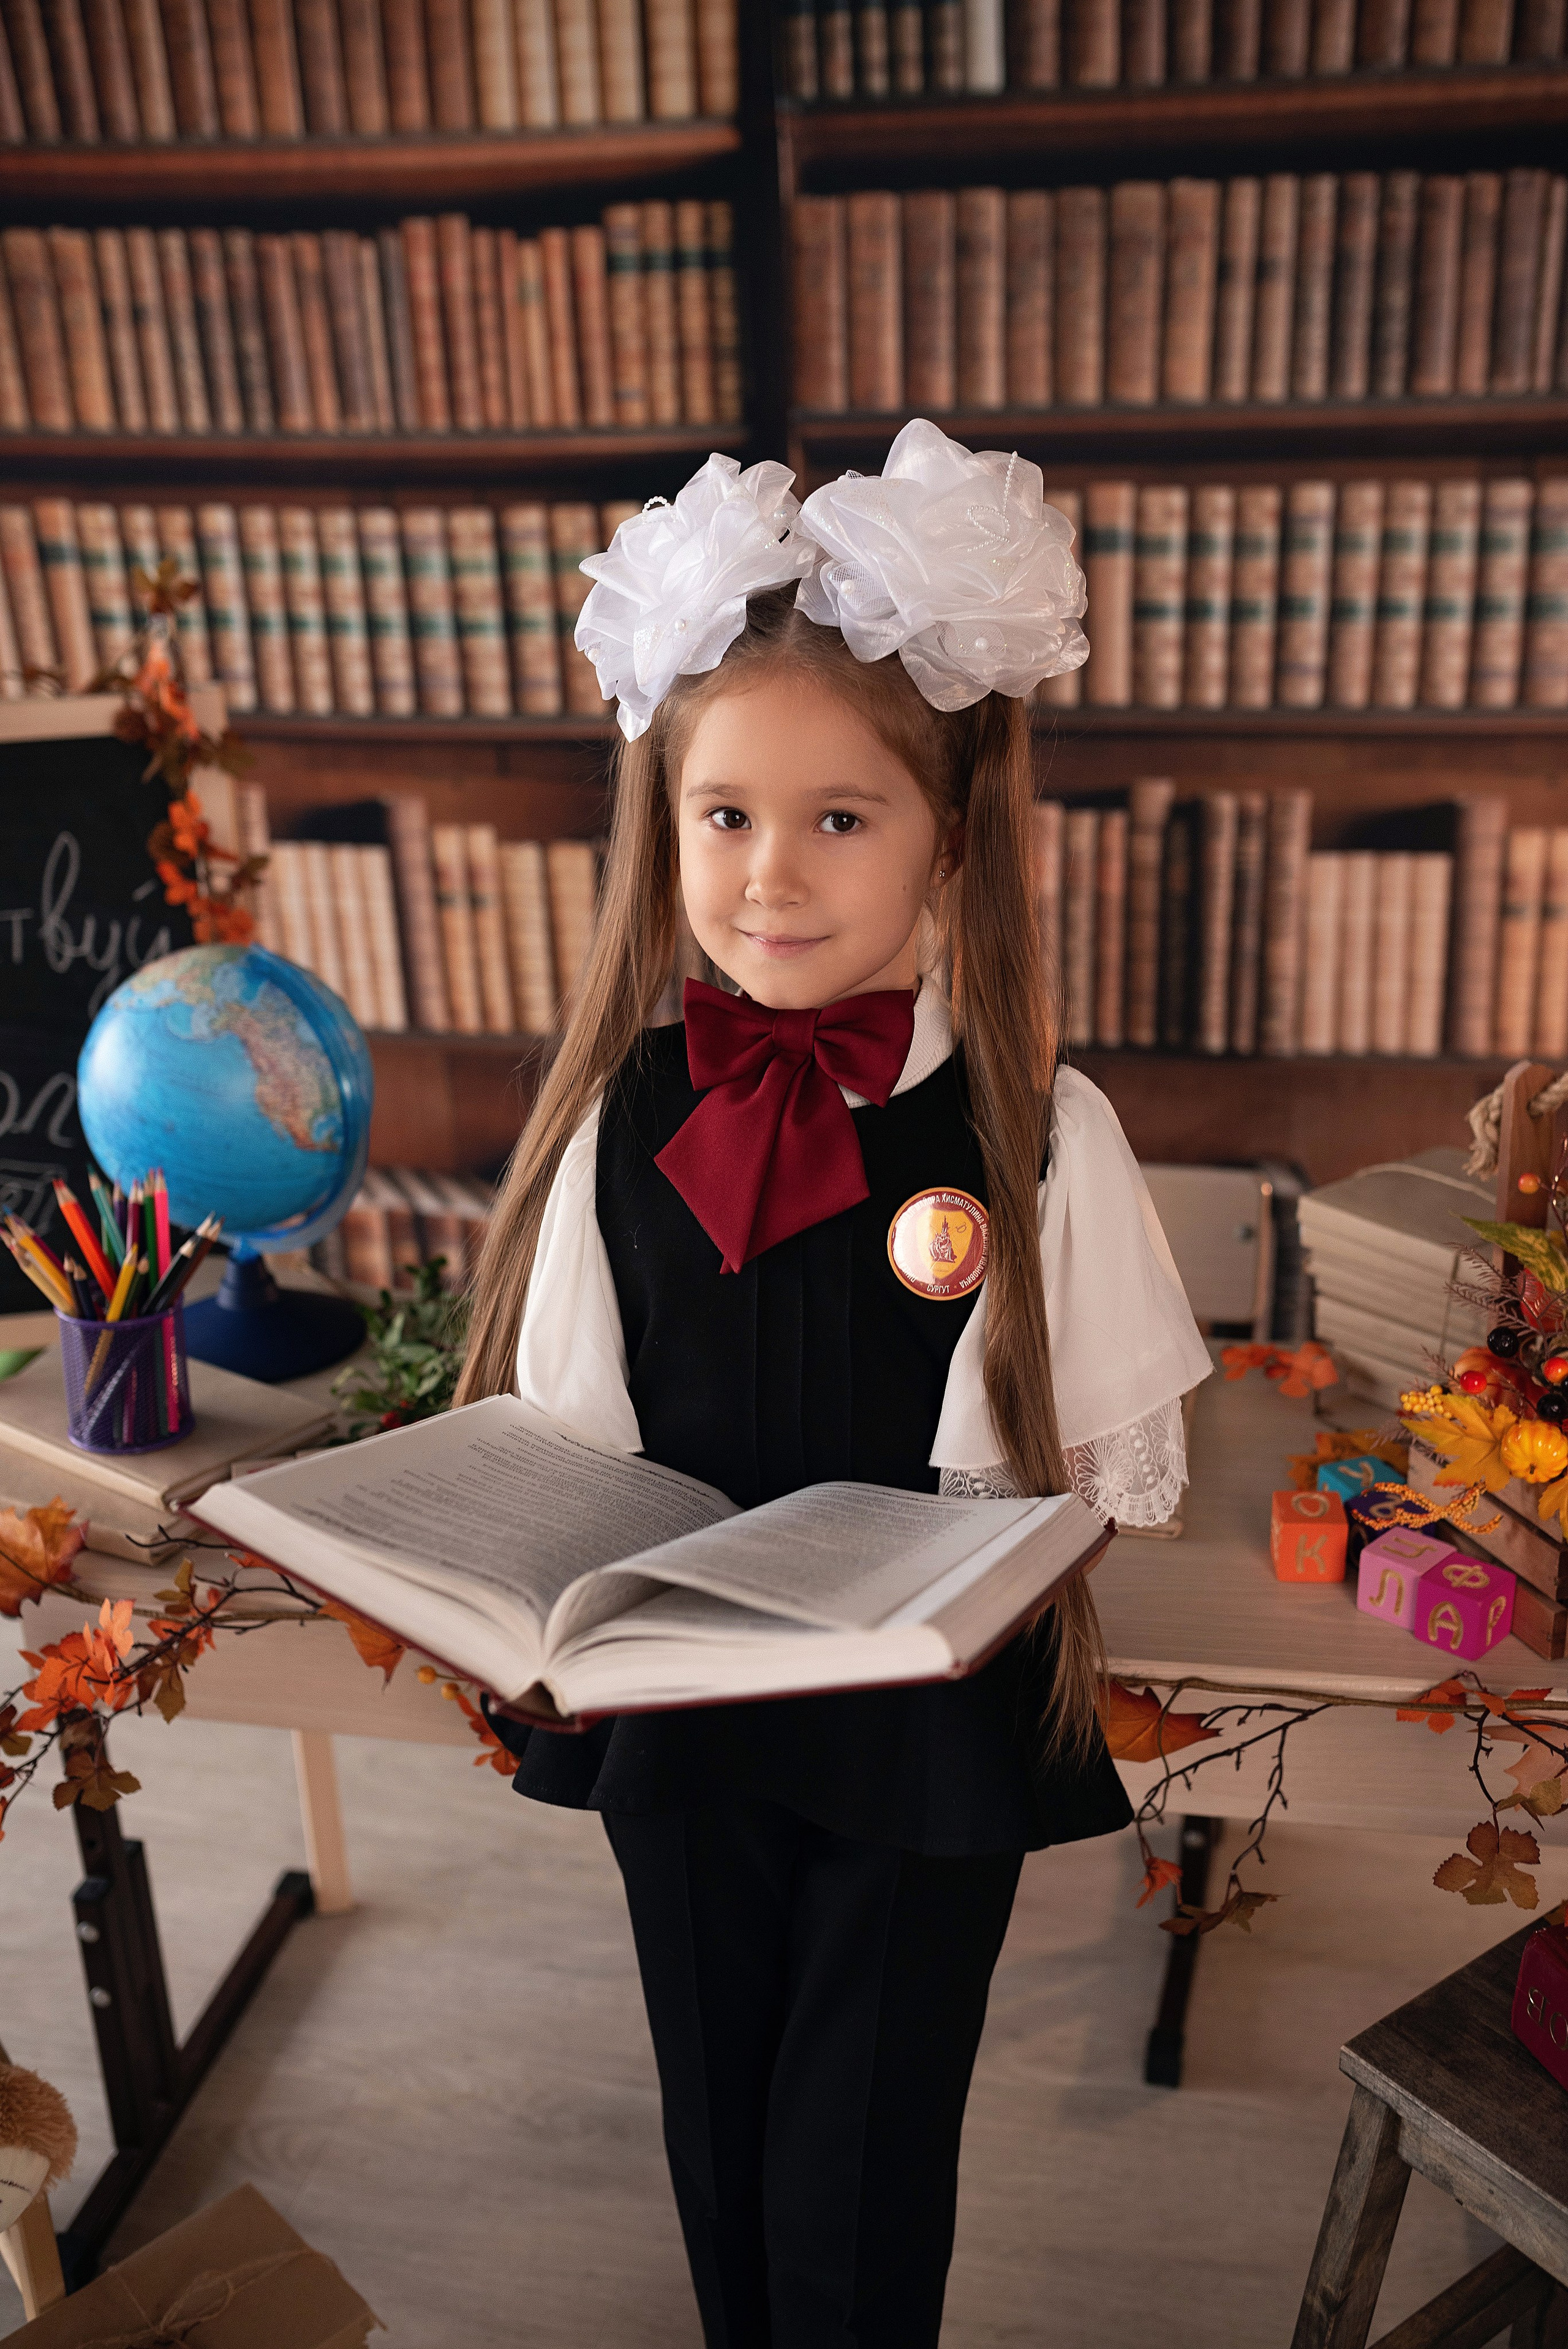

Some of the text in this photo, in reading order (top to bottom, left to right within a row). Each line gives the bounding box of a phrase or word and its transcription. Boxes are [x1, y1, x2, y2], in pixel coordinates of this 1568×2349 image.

[941, 1193, 984, 1224] ХИСМАТУЛИНА
[927, 1284, 949, 1294] СУРГУТ
[959, 1255, 987, 1289] ИВАНОВИЧА
[1295, 1534, 1328, 1574] К
[1368, 1569, 1404, 1617] Л
[1428, 1601, 1463, 1650] А
